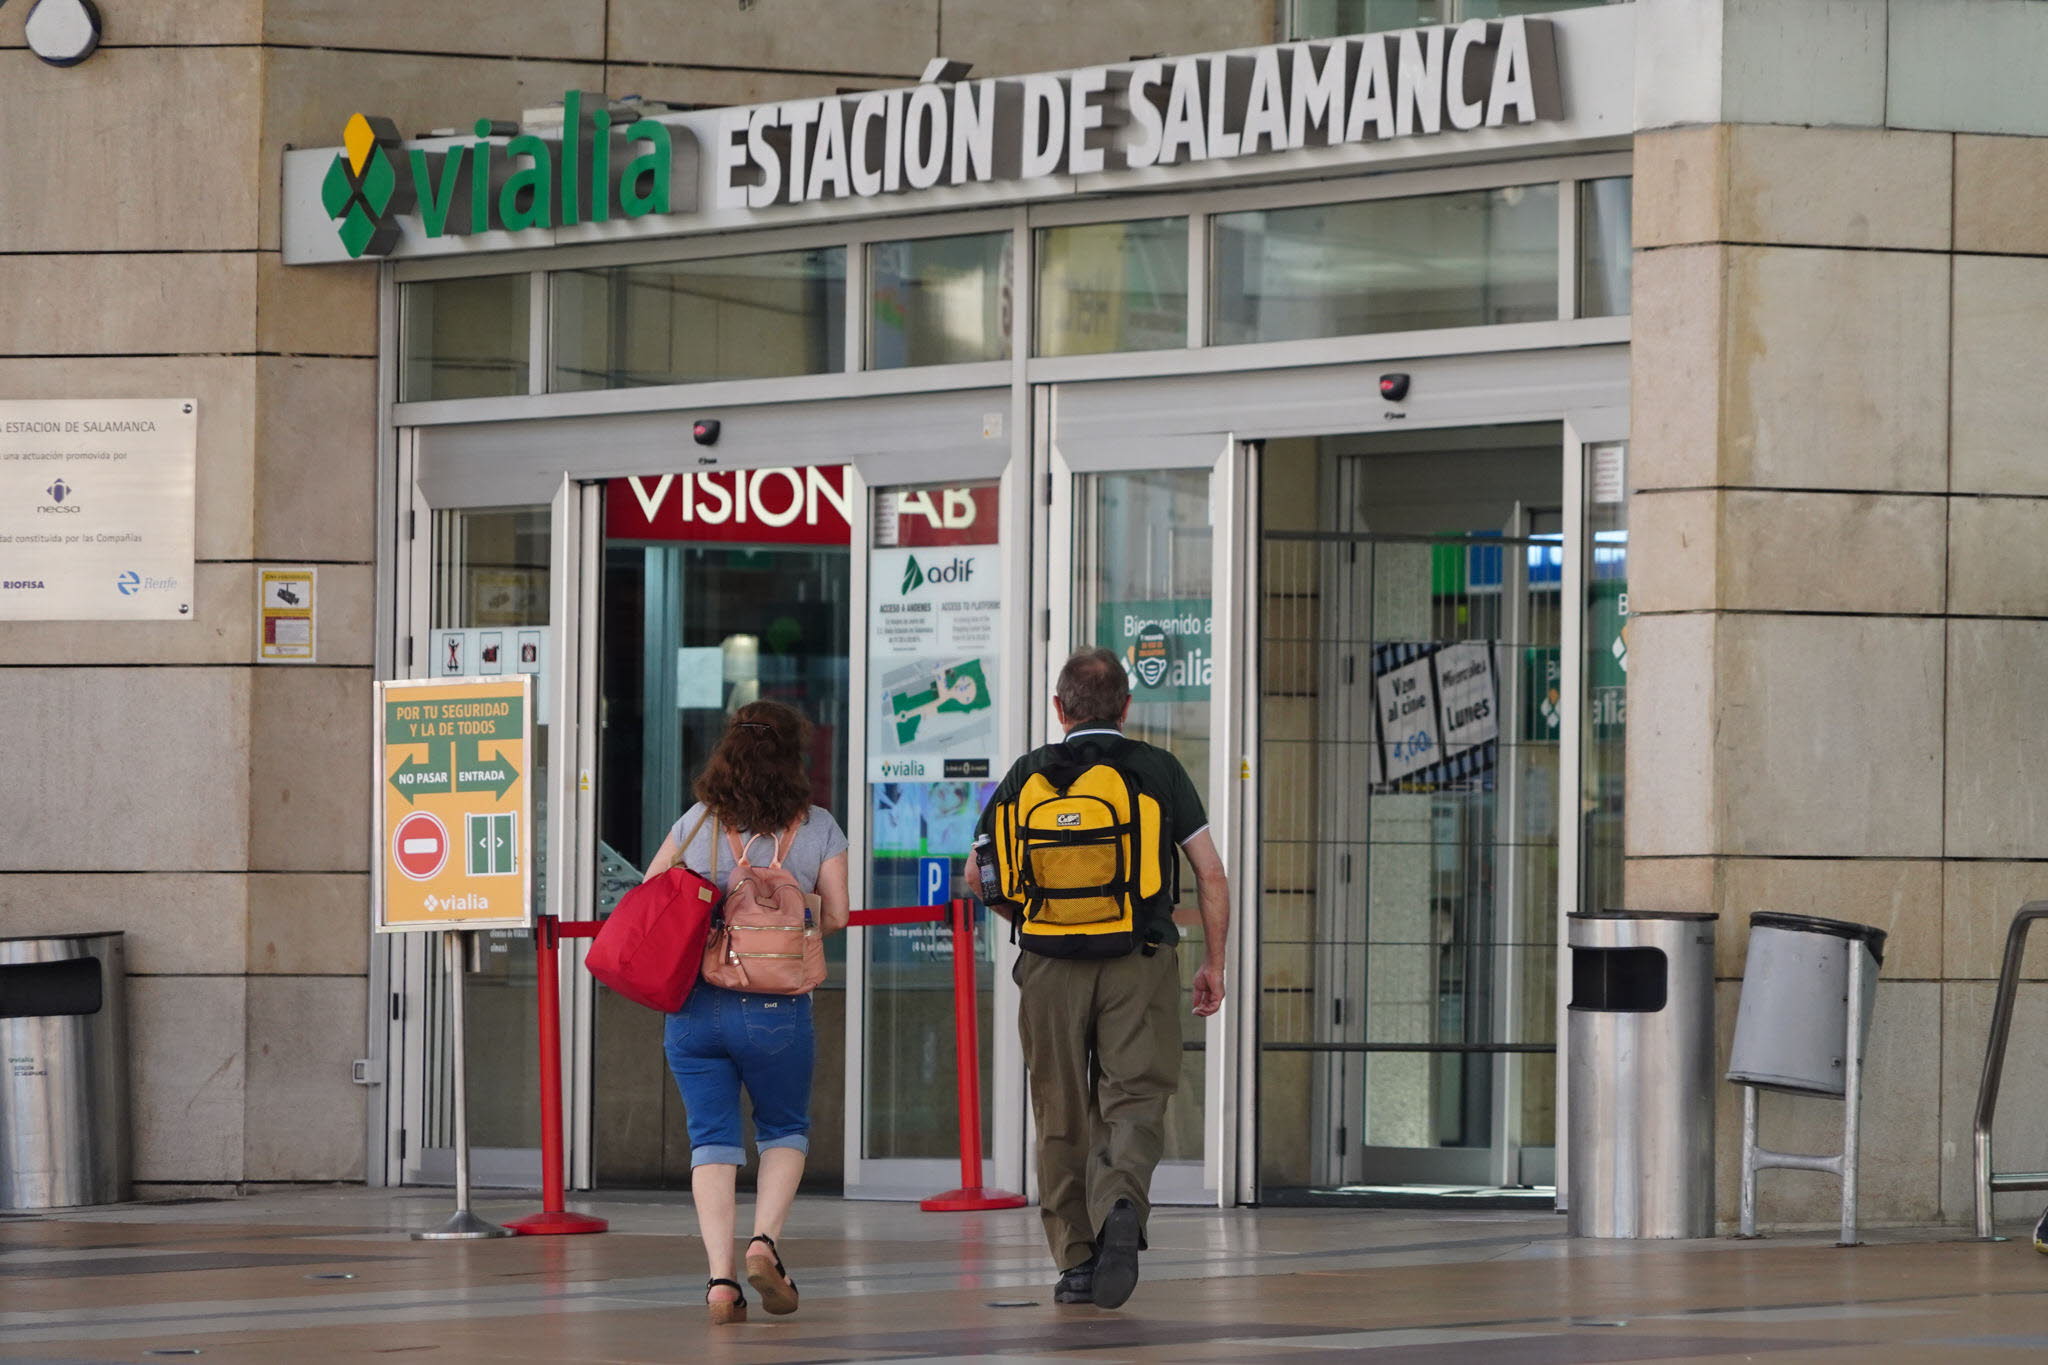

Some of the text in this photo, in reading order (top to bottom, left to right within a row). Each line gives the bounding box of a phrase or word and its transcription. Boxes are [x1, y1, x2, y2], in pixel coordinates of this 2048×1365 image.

[718, 14, 1536, 209] ESTACIÓN DE SALAMANCA
[410, 90, 672, 238] vialia
[65, 421, 80, 432] DE
[83, 420, 156, 432] SALAMANCA
[66, 450, 111, 463] promovida
[113, 451, 128, 463] por
[36, 505, 81, 513] necsa
[65, 535, 79, 545] por
[82, 533, 94, 543] las
[927, 557, 975, 584] adif
[3, 580, 45, 589] RIOFISA
[144, 576, 178, 592] Renfe
[396, 701, 509, 721] POR TU SEGURIDAD
[1446, 698, 1490, 732] Lunes
[409, 720, 496, 738] Y LA DE TODOS
[398, 769, 506, 785] NO PASAR ENTRADA
[893, 759, 925, 778] vialia
[928, 861, 942, 905] P
[440, 892, 489, 911] vialia
